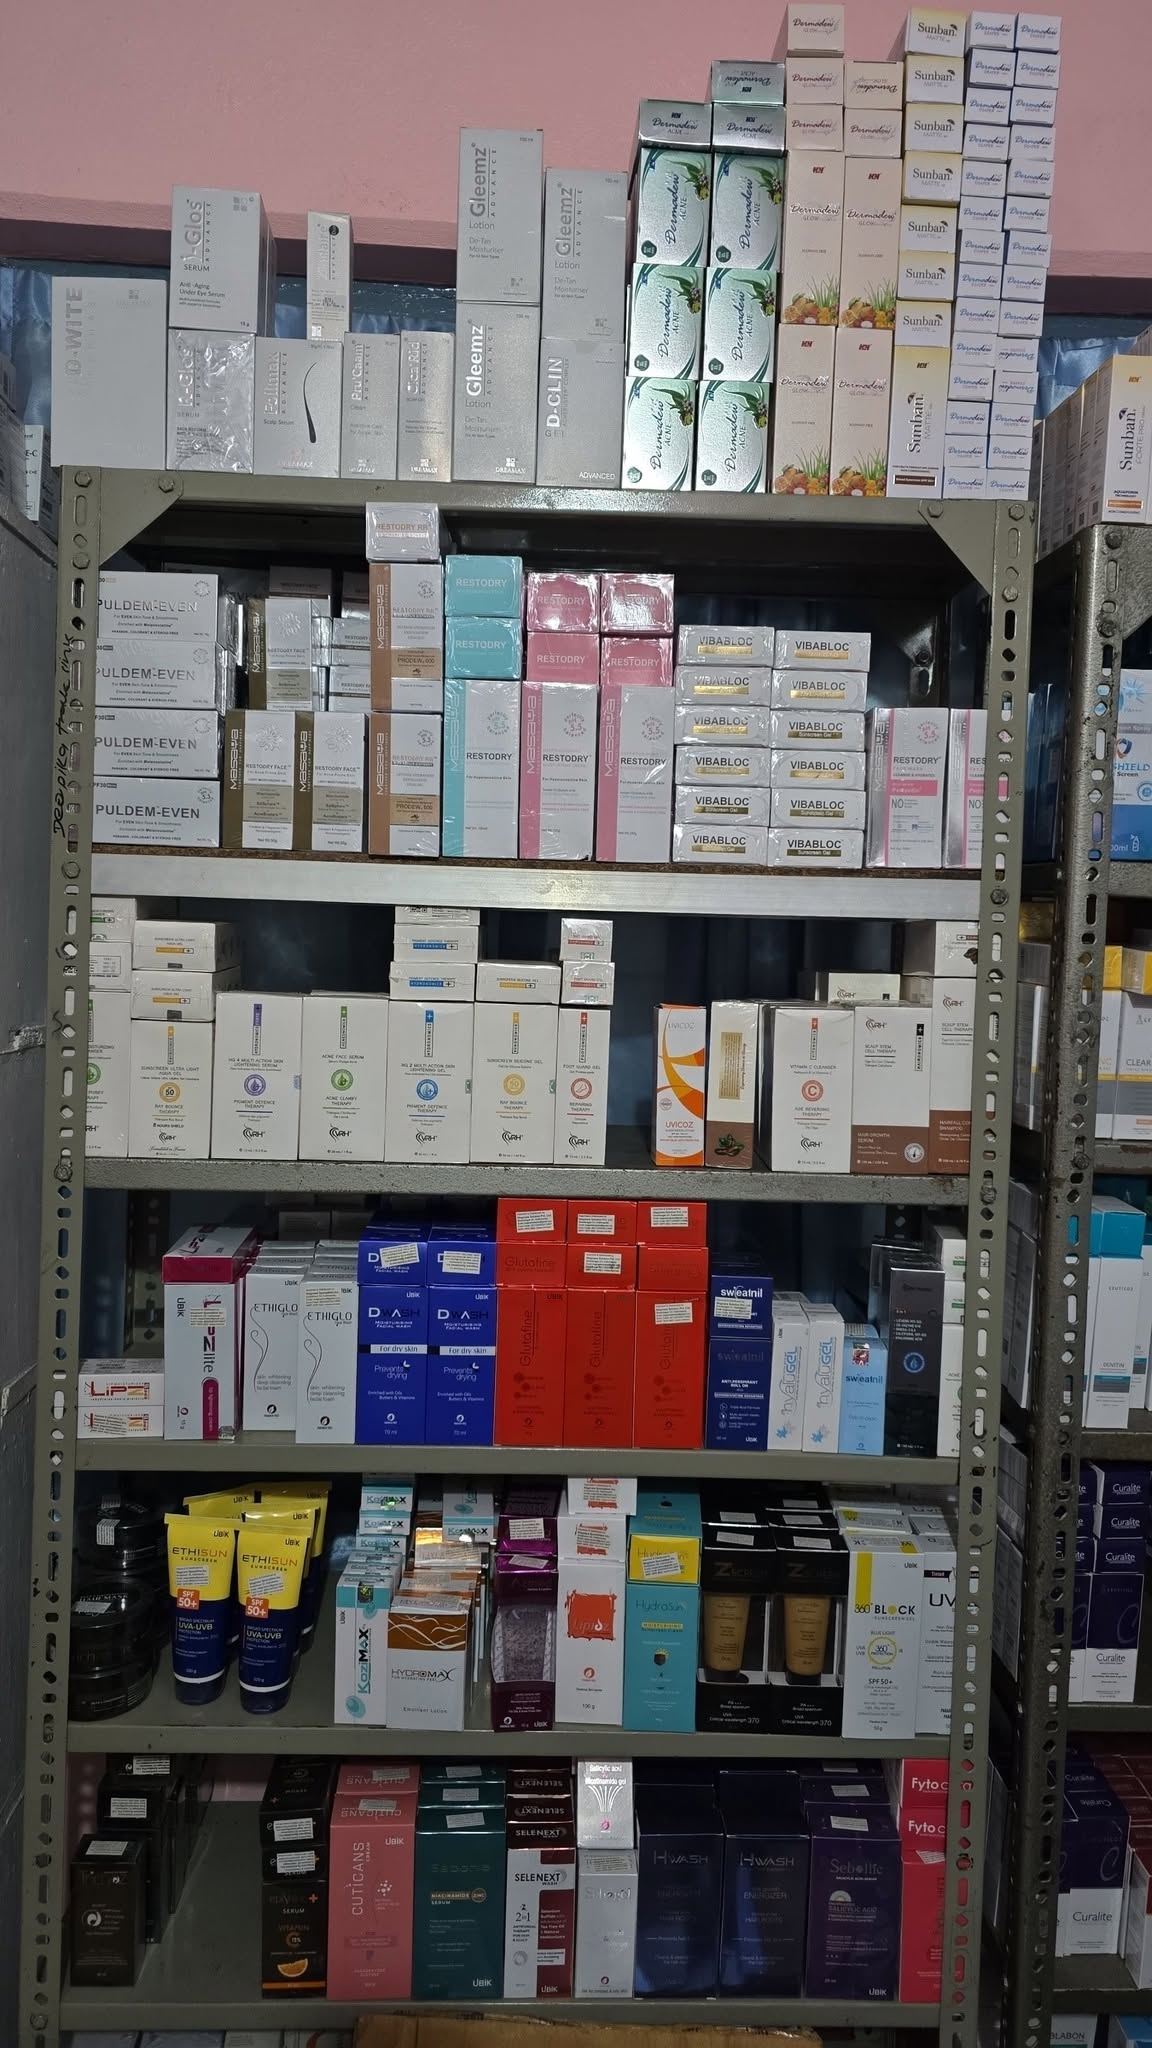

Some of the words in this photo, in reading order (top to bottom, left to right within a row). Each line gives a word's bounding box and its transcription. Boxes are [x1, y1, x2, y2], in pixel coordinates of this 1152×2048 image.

[918, 22, 955, 37] Sunban
[915, 70, 954, 83] Sunban
[914, 120, 954, 133] Sunban
[912, 168, 952, 181] Sunban
[468, 147, 487, 217] Gleemz
[665, 173, 680, 245] Dermadew
[680, 196, 688, 220] ACNE
[753, 201, 761, 225] ACNE
[739, 177, 753, 250] Dermadew
[469, 222, 494, 230] Lotion
[555, 188, 572, 257] Gleemz
[908, 221, 947, 233] Sunban
[184, 264, 210, 272] SERUM
[554, 261, 580, 270] Lotion
[906, 268, 946, 280] Sunban
[658, 287, 672, 357] Dermadew
[671, 311, 680, 334] ACNE
[732, 290, 746, 361] Dermadew
[745, 313, 753, 338] ACNE
[903, 315, 942, 326] Sunban
[466, 325, 485, 396] Gleemz
[546, 357, 563, 428] D-CLIN
[465, 400, 491, 409] Lotion
[907, 394, 925, 453] Sunban
[651, 400, 664, 470] Dermadew
[664, 423, 672, 447] ACNE
[726, 402, 739, 472] Dermadew
[738, 425, 746, 449] ACNE
[1118, 410, 1138, 471] Sunban
[578, 471, 615, 480] ADVANCED
[456, 578, 507, 588] RESTODRY
[537, 595, 586, 605] RESTODRY
[455, 639, 506, 649] RESTODRY
[699, 636, 752, 646] VIBABLOC
[795, 641, 849, 651] VIBABLOC
[537, 655, 586, 664] RESTODRY
[610, 657, 659, 667] RESTODRY
[792, 681, 846, 691] VIBABLOC
[694, 716, 748, 726] VIBABLOC
[789, 721, 843, 731] VIBABLOC
[95, 737, 197, 750] PULDEM-EVEN
[466, 752, 512, 761] RESTODRY
[542, 754, 589, 762] RESTODRY
[620, 757, 666, 766] RESTODRY
[893, 756, 938, 764] RESTODRY
[695, 757, 749, 767] VIBABLOC
[790, 761, 844, 771] VIBABLOC
[695, 796, 749, 806] VIBABLOC
[790, 800, 844, 810] VIBABLOC
[891, 799, 903, 808] NO
[969, 800, 981, 808] NO
[96, 805, 200, 819] PULDEM-EVEN
[692, 835, 746, 845] VIBABLOC
[787, 839, 841, 849] VIBABLOC
[1126, 1058, 1152, 1066] CLEAR
[165, 1088, 175, 1096] 50
[665, 1121, 693, 1129] UVICOZ
[254, 1303, 298, 1313] ETHIGLO
[307, 1312, 352, 1321] ETHIGLO
[380, 1345, 390, 1353] For
[391, 1345, 402, 1354] dry
[404, 1345, 418, 1353] skin
[460, 1347, 471, 1355] dry
[473, 1347, 487, 1355] skin
[386, 1372, 408, 1381] drying
[456, 1373, 477, 1382] drying
[1113, 1484, 1141, 1493] Curalite
[1111, 1518, 1140, 1527] Curalite
[172, 1547, 228, 1558] ETHISUN
[1106, 1552, 1136, 1562] Curalite
[242, 1554, 298, 1566] ETHISUN
[178, 1598, 198, 1608] 50+
[251, 1598, 264, 1606] SPF
[246, 1606, 266, 1616] 50+
[854, 1603, 870, 1614] 360
[179, 1622, 213, 1631] UVA-UVB
[247, 1631, 281, 1640] UVA-UVB
[1096, 1654, 1126, 1662] Curalite
[911, 1778, 939, 1791] Fyto
[515, 1828, 561, 1837] SELENEXT
[908, 1821, 936, 1834] Fyto
[352, 1842, 365, 1916] CUTICANS
[514, 1872, 561, 1883] SELENEXT
[1072, 1912, 1113, 1922] Curalite
